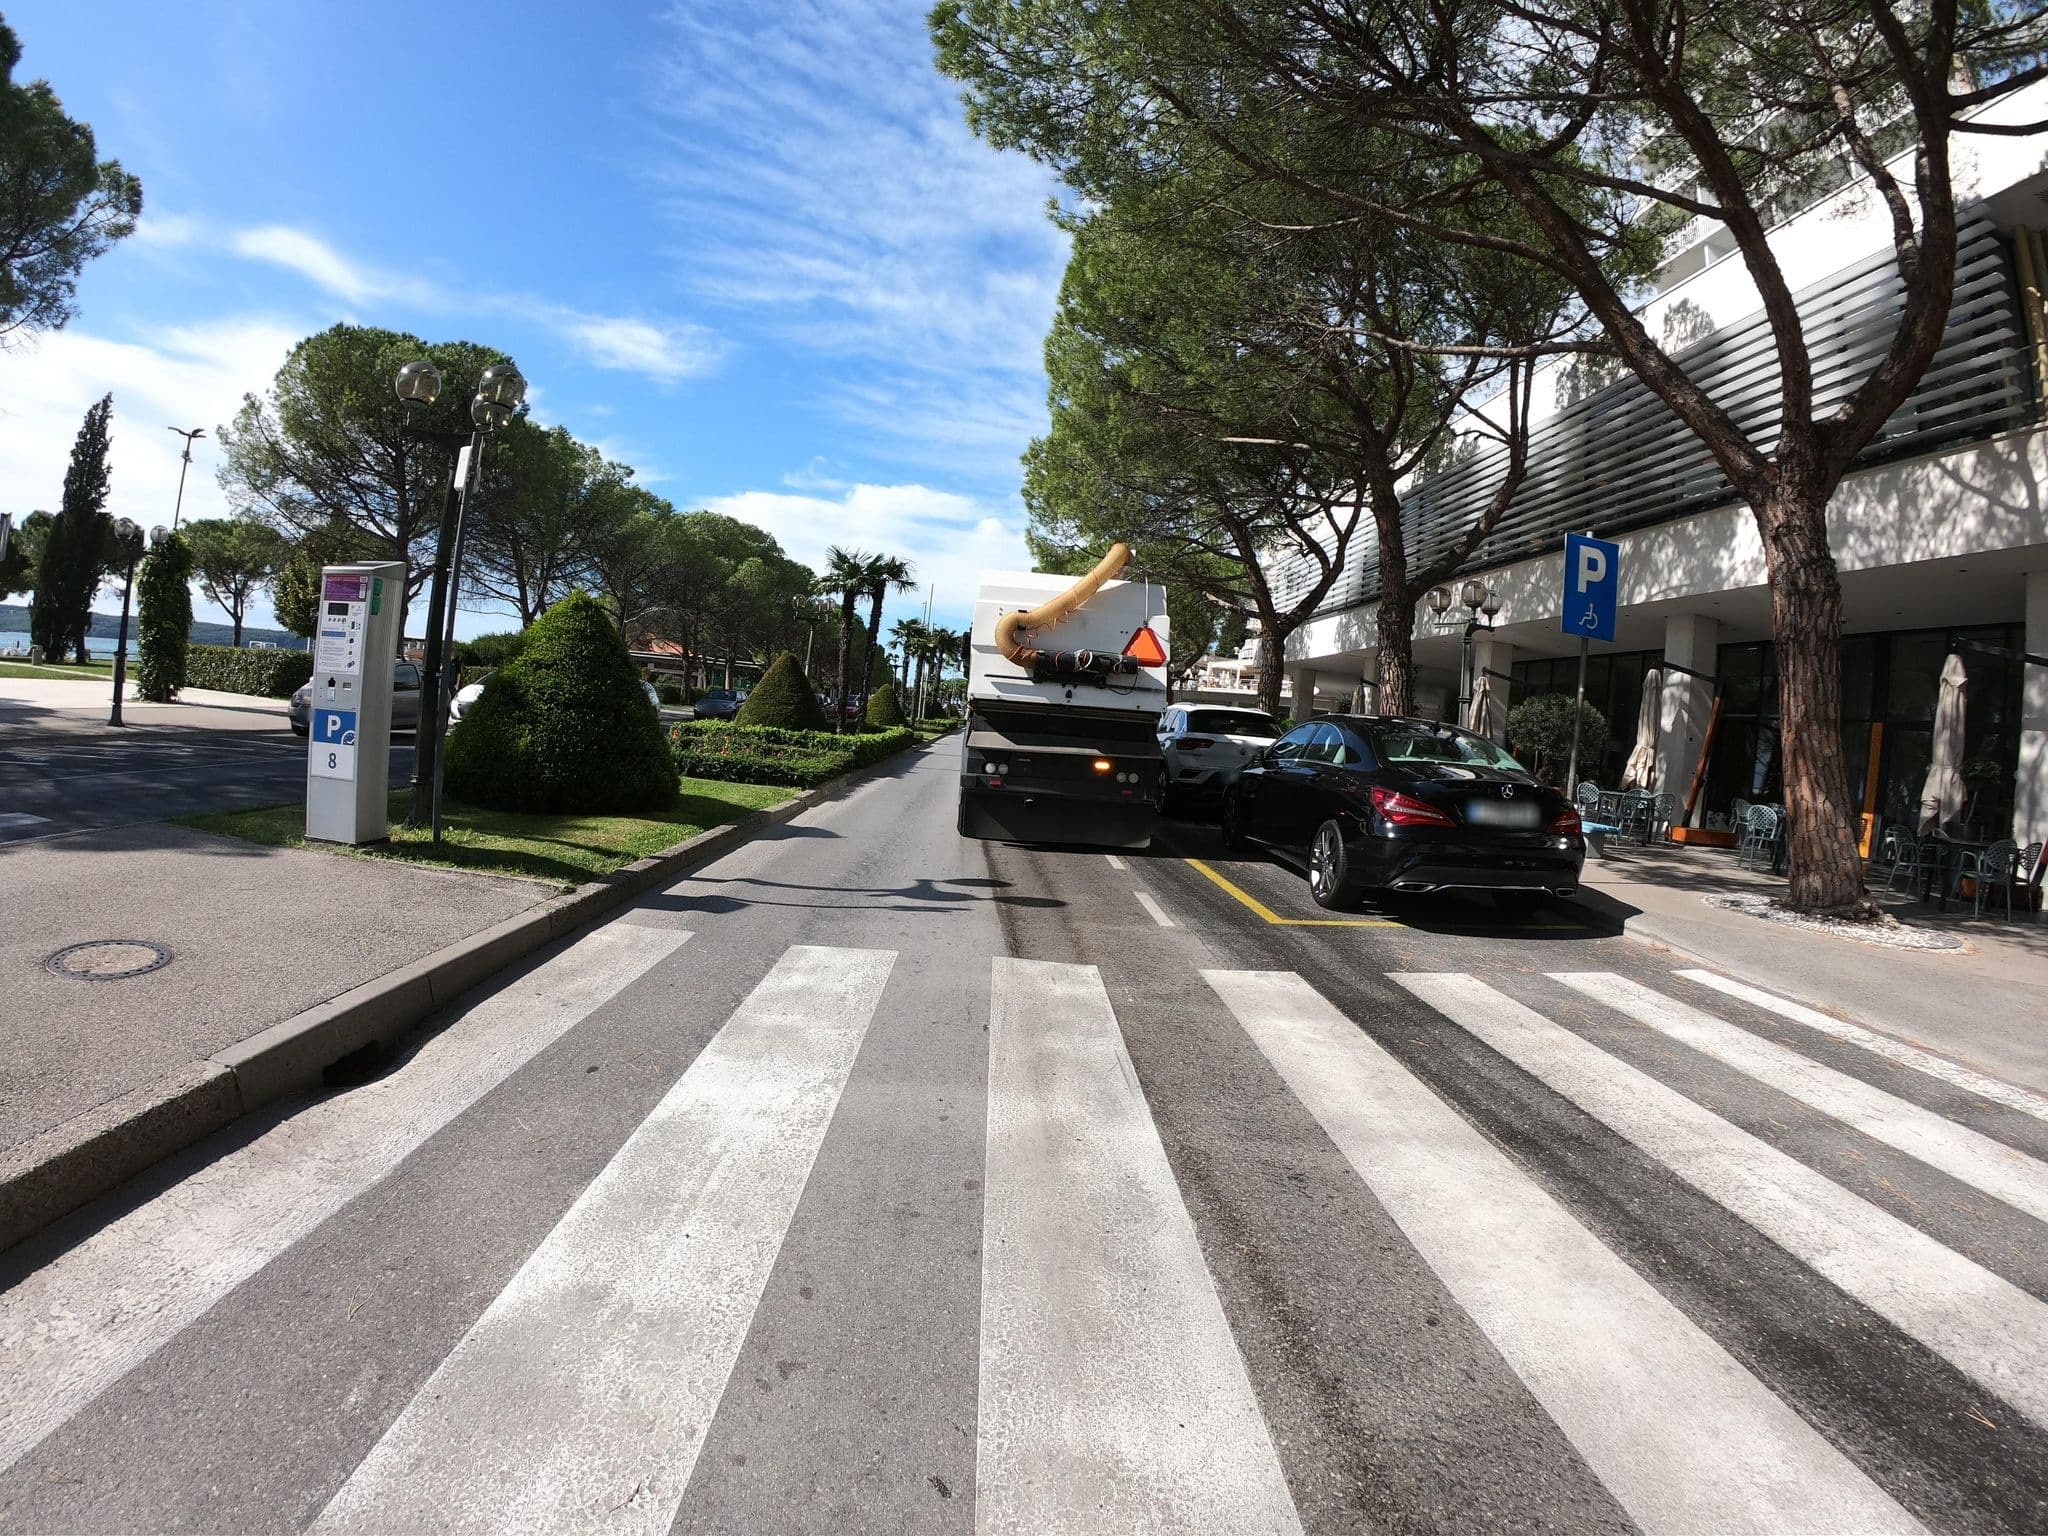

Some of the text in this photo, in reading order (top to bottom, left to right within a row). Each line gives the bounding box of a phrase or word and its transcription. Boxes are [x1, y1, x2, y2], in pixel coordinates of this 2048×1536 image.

[1577, 545, 1606, 593] P
[327, 715, 341, 737] P
[328, 752, 337, 769] 8
